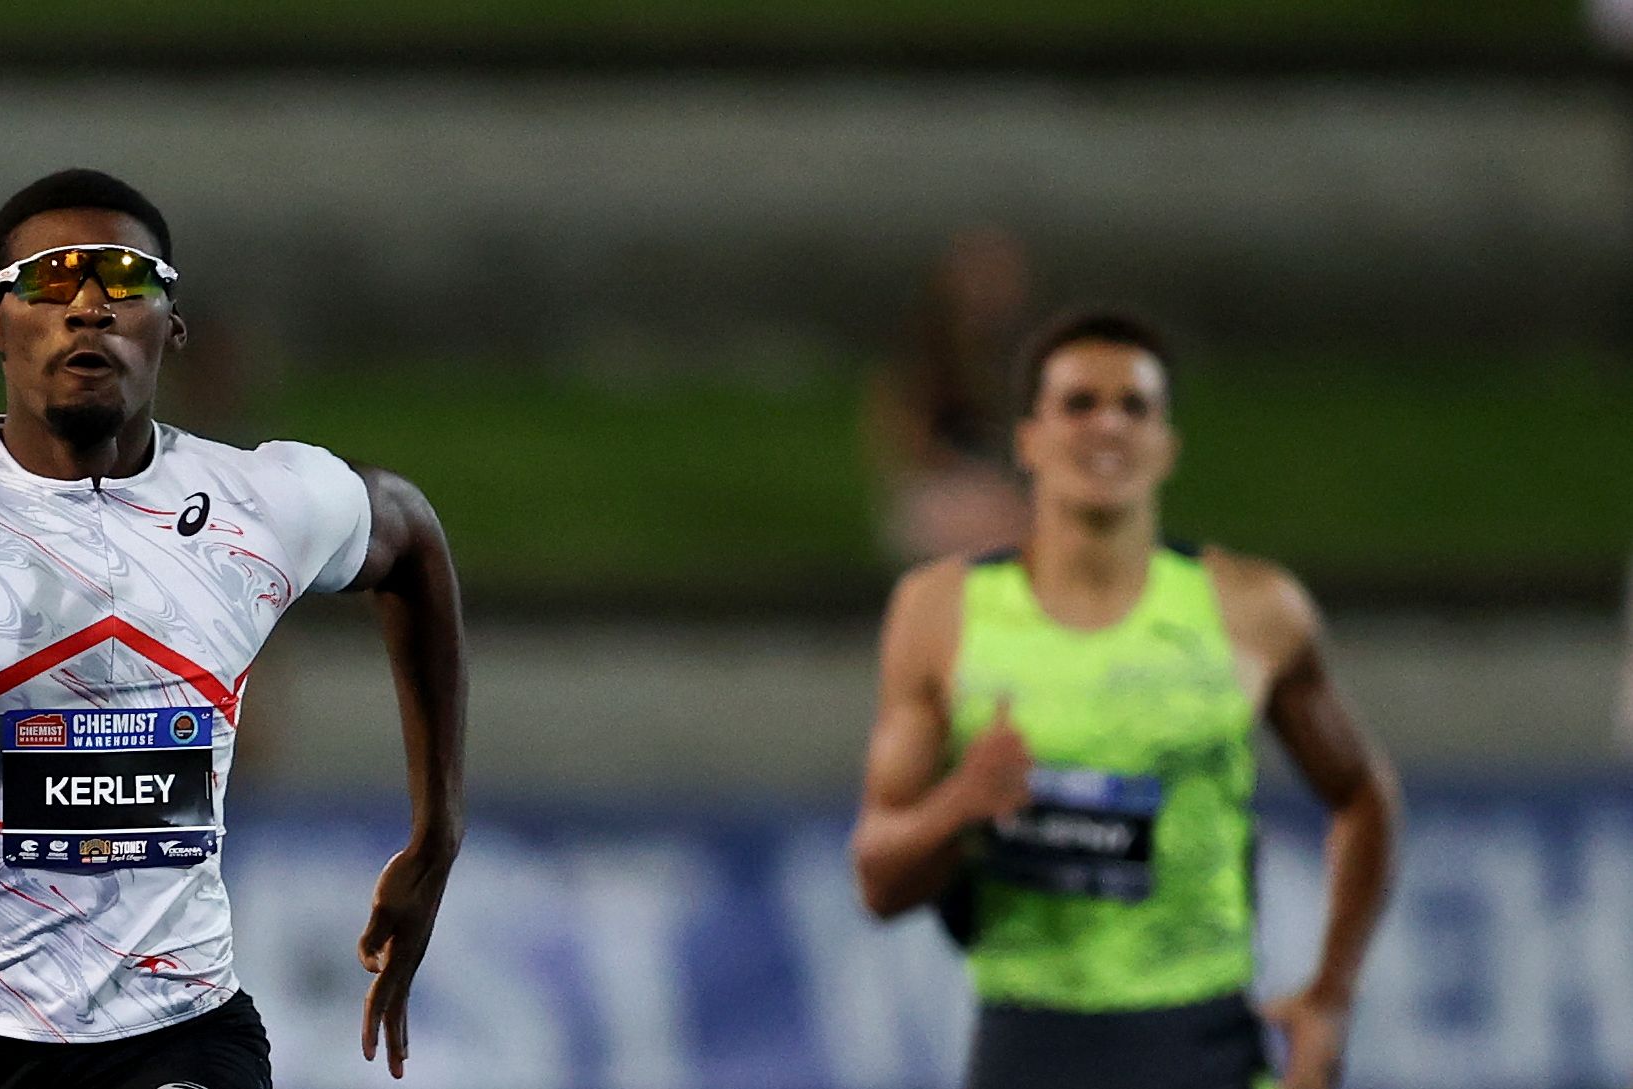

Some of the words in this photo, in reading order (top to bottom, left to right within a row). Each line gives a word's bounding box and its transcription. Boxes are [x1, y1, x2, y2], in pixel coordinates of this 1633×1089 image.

[72, 712, 158, 735] CHEMIST
[19, 725, 63, 737] CHEMIST
[73, 735, 154, 747] WAREHOUSE
[45, 774, 175, 805] KERLEY
[112, 840, 148, 854] SYDNEY
